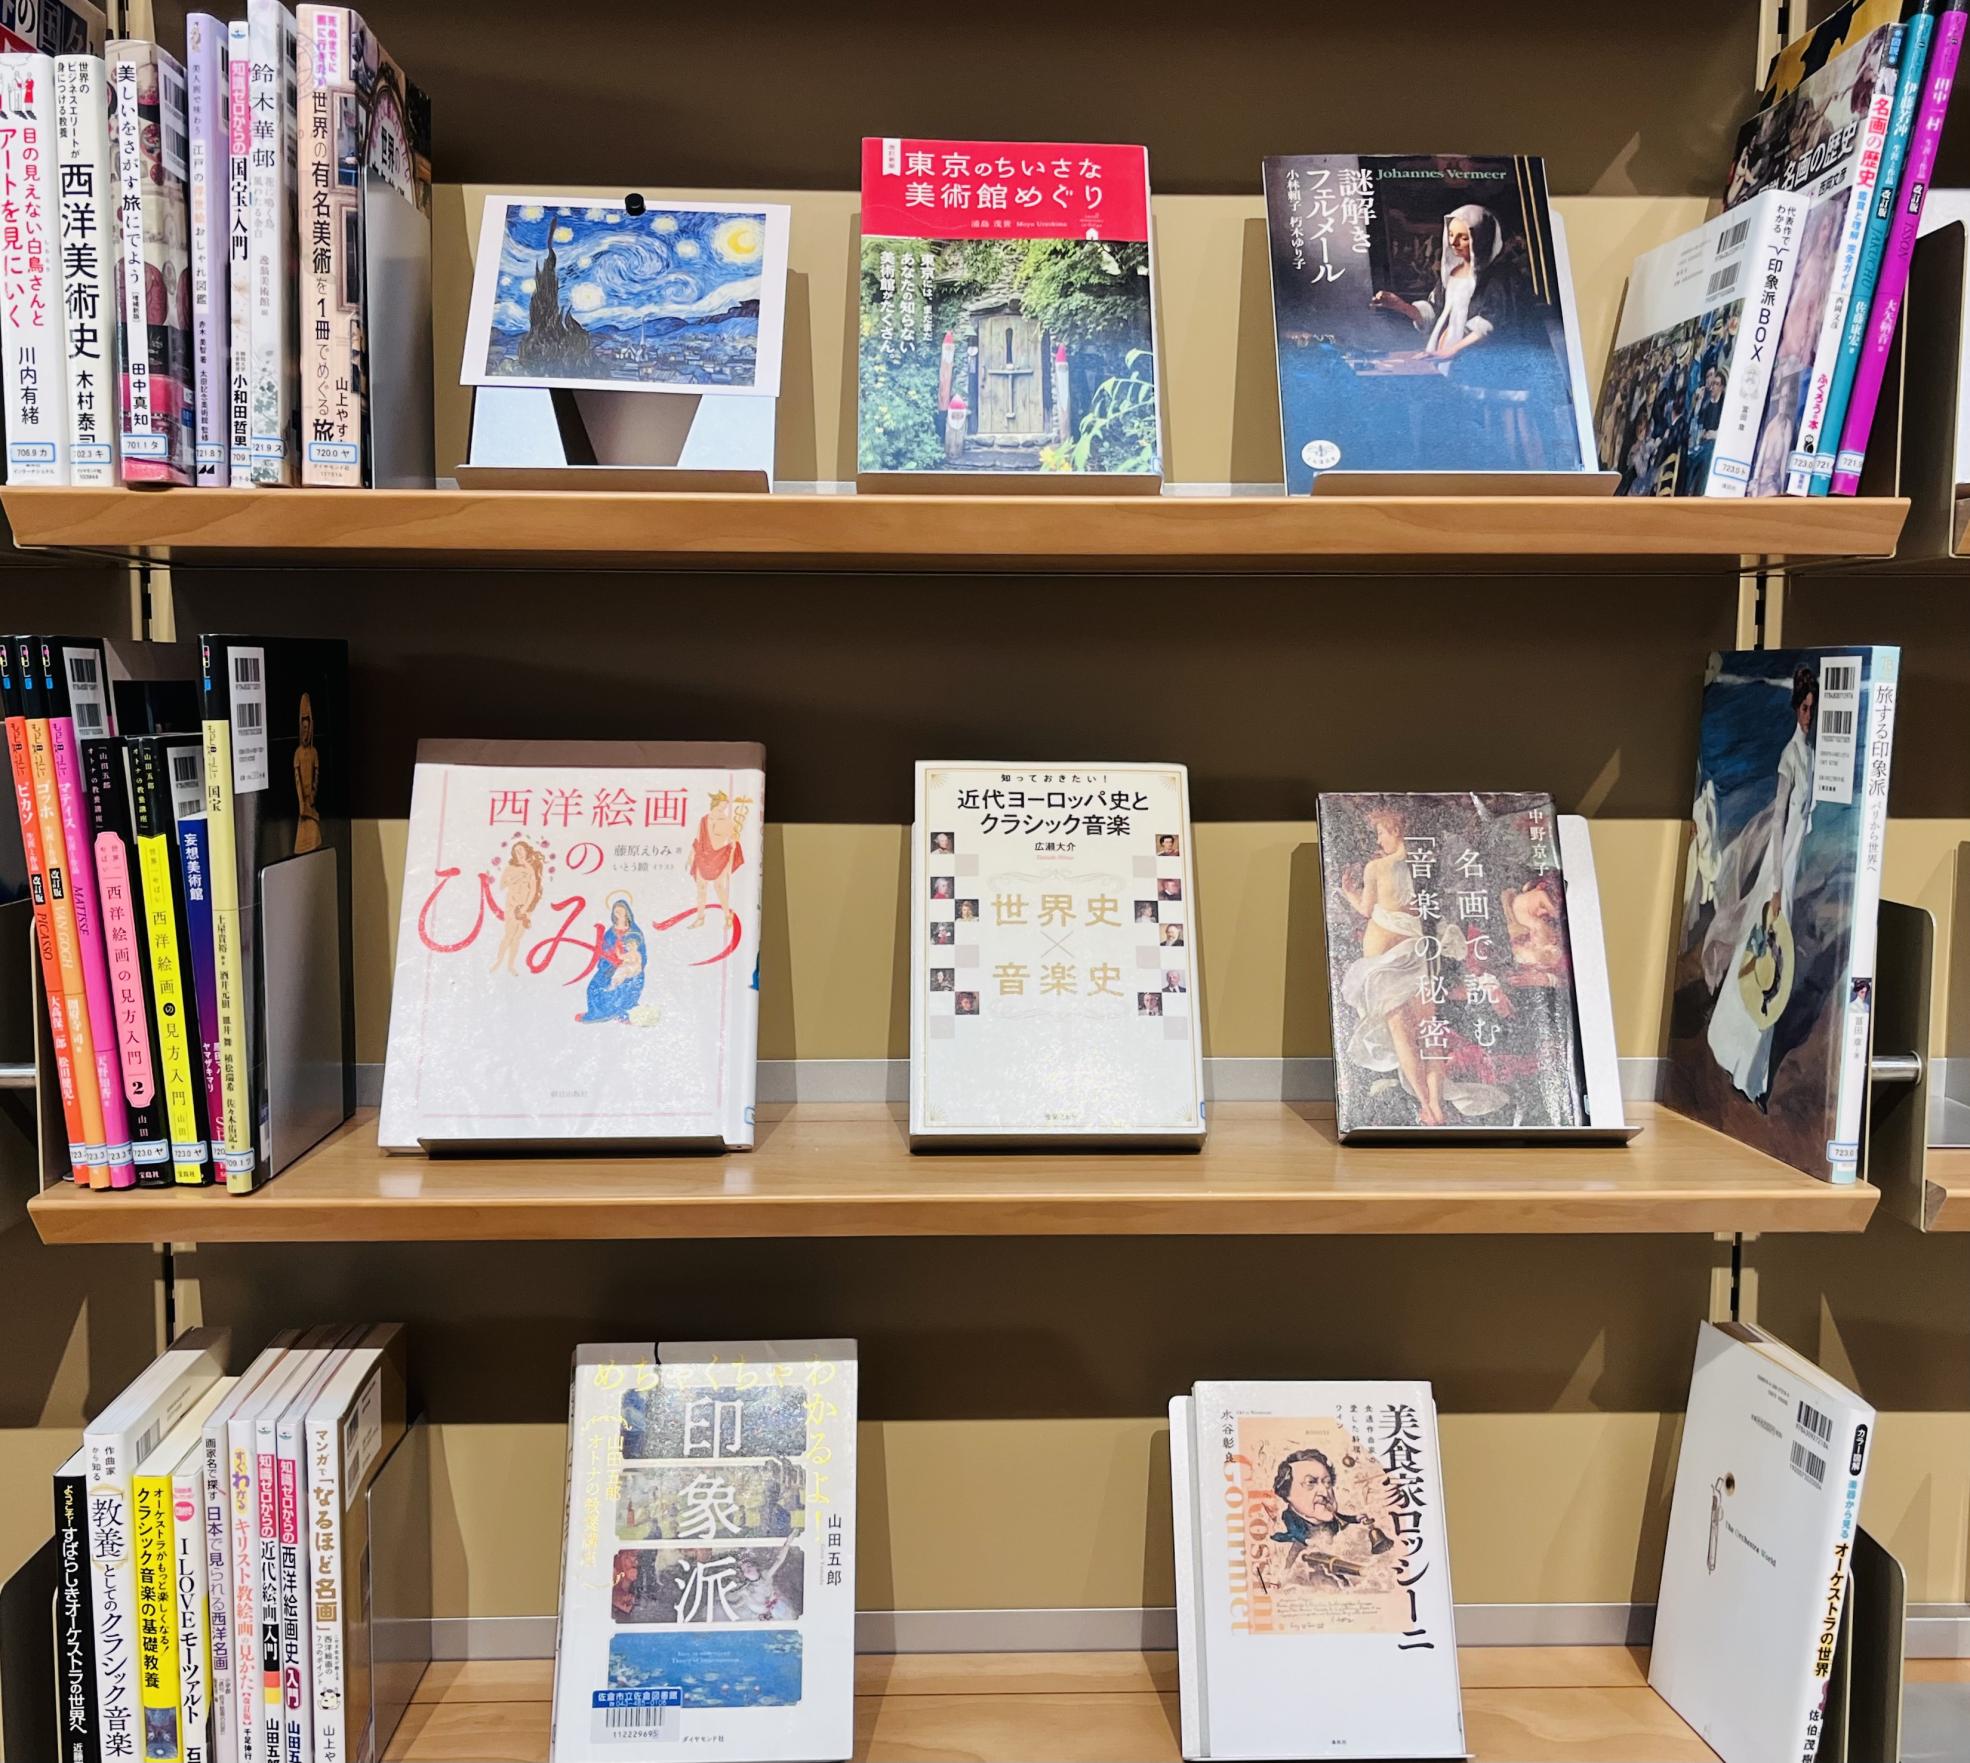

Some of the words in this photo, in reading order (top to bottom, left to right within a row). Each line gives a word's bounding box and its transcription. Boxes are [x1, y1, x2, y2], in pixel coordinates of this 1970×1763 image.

[57, 62, 68, 138] 身につける教養
[67, 63, 81, 159] ビジネスエリートが
[79, 62, 90, 94] 世界の
[232, 63, 247, 154] 知識ゼロからの
[251, 63, 275, 168] 鈴木華邨
[1856, 97, 1889, 188] 名画の歴史
[118, 65, 142, 284] 美しいをさがす旅にでよう
[904, 150, 1102, 179] 東京のちいさな
[1286, 168, 1302, 212] 小林頼子
[1375, 168, 1444, 181] Johannes
[1447, 169, 1507, 180] Vermeer
[1781, 121, 1859, 191] 名画の歴史
[0, 128, 25, 328] アートを見にいく
[23, 128, 45, 327] 目の見えない白鳥さんと
[231, 157, 248, 260] 国宝入門
[904, 181, 1103, 210] 美術館めぐり
[1306, 169, 1346, 284] フェルメール
[1337, 168, 1378, 253] 謎解き
[1773, 205, 1786, 234] わかる
[1782, 206, 1797, 246] 代表作で
[60, 164, 100, 359] 西洋美術史
[311, 92, 335, 442] 世界の有名美術を1冊でめぐる旅
[879, 250, 896, 359] 美術館がたくさん。
[900, 252, 915, 354] あなたの知らない
[1750, 258, 1784, 362] 印象派BOX
[18, 346, 39, 424] 川内有緒
[132, 363, 149, 427] 田中真知
[335, 376, 349, 442] 山上やす
[1868, 685, 1894, 797] 旅する印象派
[17, 782, 33, 825] ピカソ
[37, 779, 55, 818] ゴッホ
[58, 782, 77, 829] マティス
[488, 787, 689, 829] 西洋絵画
[957, 789, 1150, 811] 近代ヨーロッパ史と
[1001, 773, 1109, 784] 知っておきたい!
[565, 841, 605, 876] の
[614, 844, 672, 857] 藤原えりみ
[980, 813, 1131, 836] クラシック音楽
[1034, 841, 1076, 851] 広瀬大介
[1528, 808, 1550, 877] 中野京子
[1866, 800, 1882, 872] パリから世界へ
[50, 869, 63, 898] 改訂版
[183, 833, 204, 901] 妄想美術館
[37, 912, 54, 961] PICASSO
[72, 885, 90, 937] MATISSE
[417, 866, 743, 987] ひみつ
[991, 893, 1123, 927] 世界史
[992, 962, 1124, 997] 音楽史
[1403, 835, 1454, 1061] 「音楽の秘密」
[1455, 848, 1501, 1048] 名画で読む
[107, 885, 143, 1065] 西洋絵画の見方入門
[132, 1081, 145, 1095] 2
[152, 911, 187, 1106] 西洋絵画の見方入門
[203, 1042, 214, 1093] ヤマザキマリ
[1220, 1408, 1236, 1464] 水谷彰良
[1335, 1404, 1345, 1430] ワイン
[92, 1448, 101, 1481] から知る
[104, 1446, 116, 1475] 作曲家
[205, 1438, 219, 1501] 画家名で探す
[231, 1448, 250, 1511] すぐわかる
[258, 1455, 274, 1537] 知識ゼロからの
[280, 1460, 295, 1544] 知識ゼロからの
[673, 1395, 745, 1625] 印象派
[1378, 1402, 1435, 1651] 美食家ロッシーニ
[154, 1488, 170, 1656] オーケストラがもっと楽しくなる!
[826, 1513, 843, 1587] 山田五郎
[1223, 1453, 1254, 1633] Gourmet
[137, 1487, 160, 1689] クラシック音楽の基礎教養
[207, 1505, 228, 1671] 日本で見られる西洋名画
[260, 1540, 277, 1622] 近代絵画
[282, 1545, 300, 1665] 西洋絵画史
[1815, 1543, 1849, 1677] オーケストラの世界
[91, 1498, 133, 1757] 教養としてのクラシック音楽
[263, 1626, 278, 1661] 入門
[180, 1632, 202, 1724] モーツァルト
[286, 1669, 299, 1707] 入門
[598, 1691, 678, 1701] 佐倉市立佐倉図書館
[322, 1724, 336, 1762] 山上や
[613, 1729, 658, 1739] 112229695
[682, 1735, 724, 1743] ダイヤモンド社
